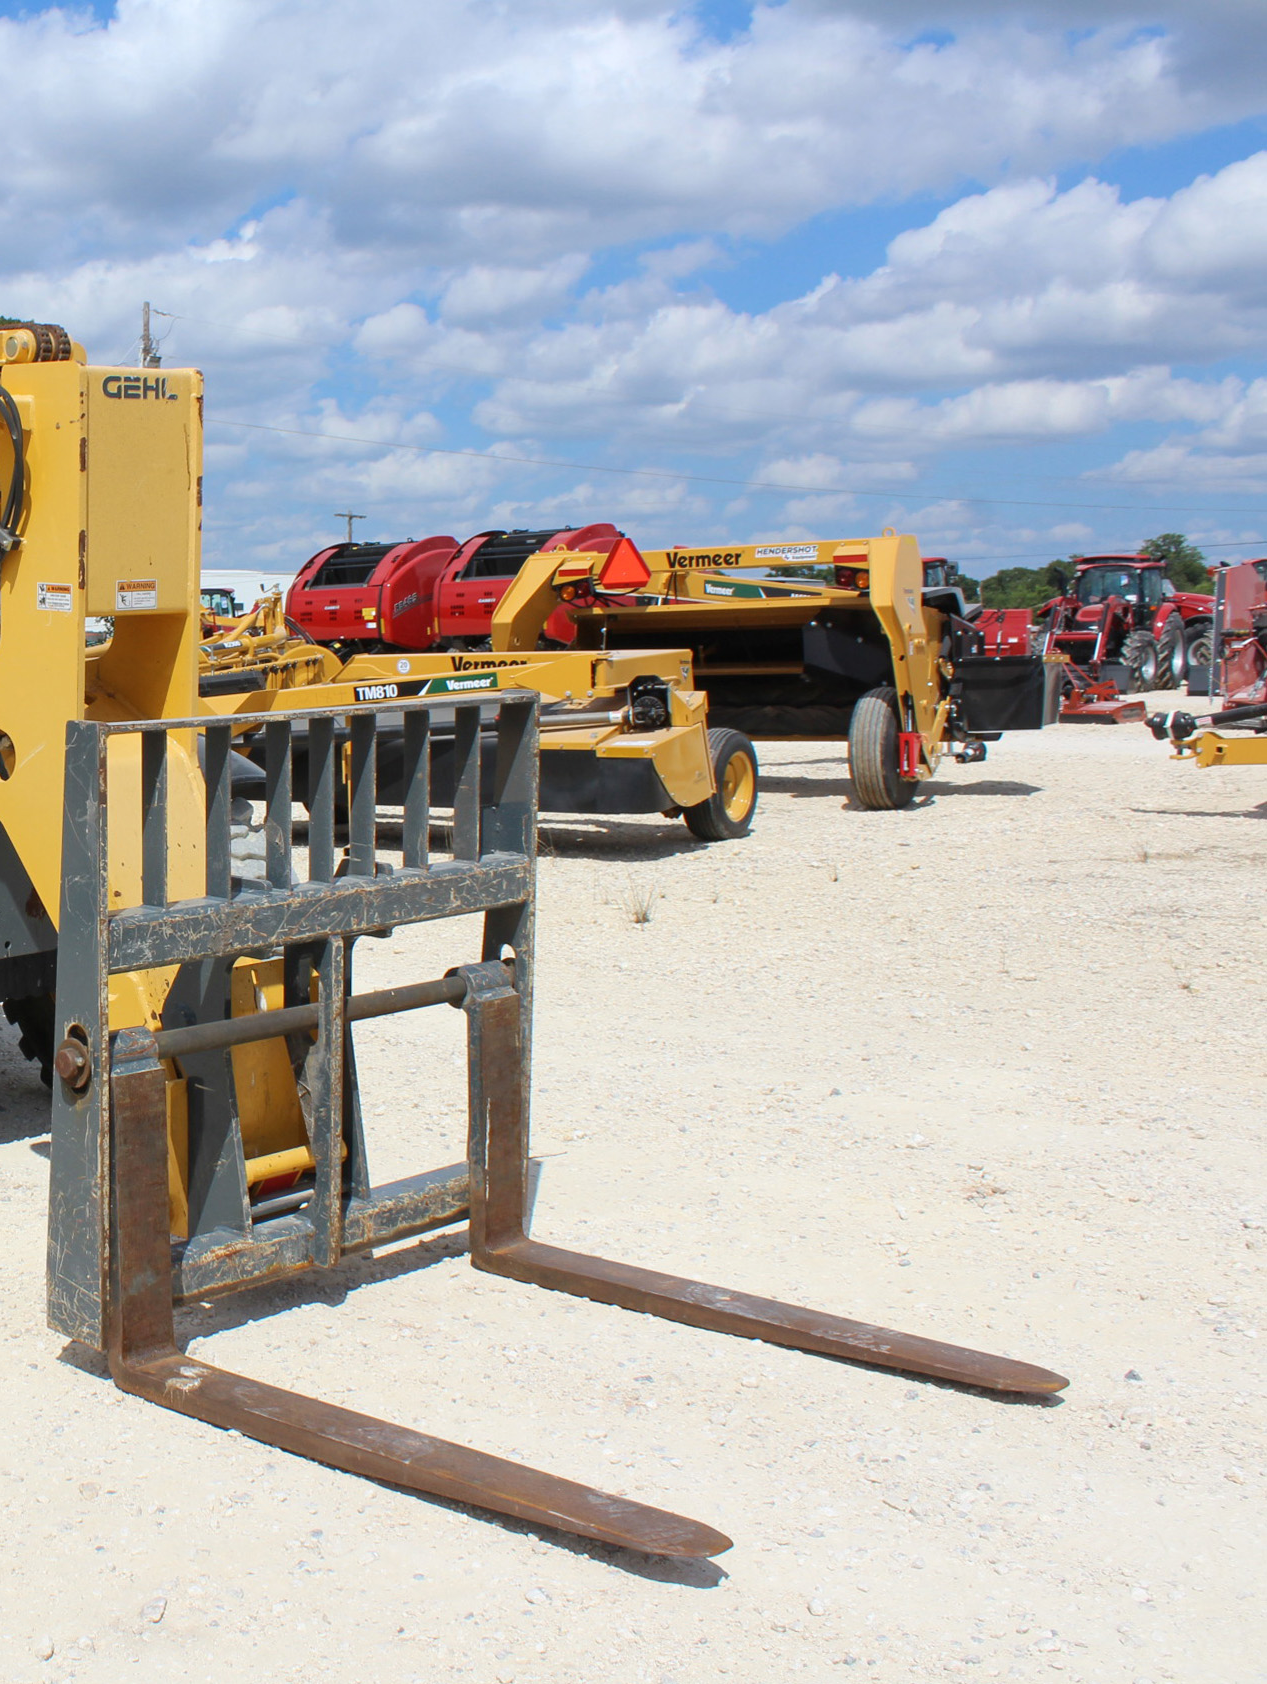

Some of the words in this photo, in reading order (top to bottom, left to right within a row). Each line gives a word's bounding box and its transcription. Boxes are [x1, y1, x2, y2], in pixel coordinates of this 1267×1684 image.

[102, 375, 178, 401] GEHL
[757, 545, 817, 556] HENDERSHOT
[666, 551, 742, 569] Vermeer
[705, 583, 734, 596] Vermeer
[356, 684, 398, 701] TM810
[446, 678, 492, 691] Vermeer
